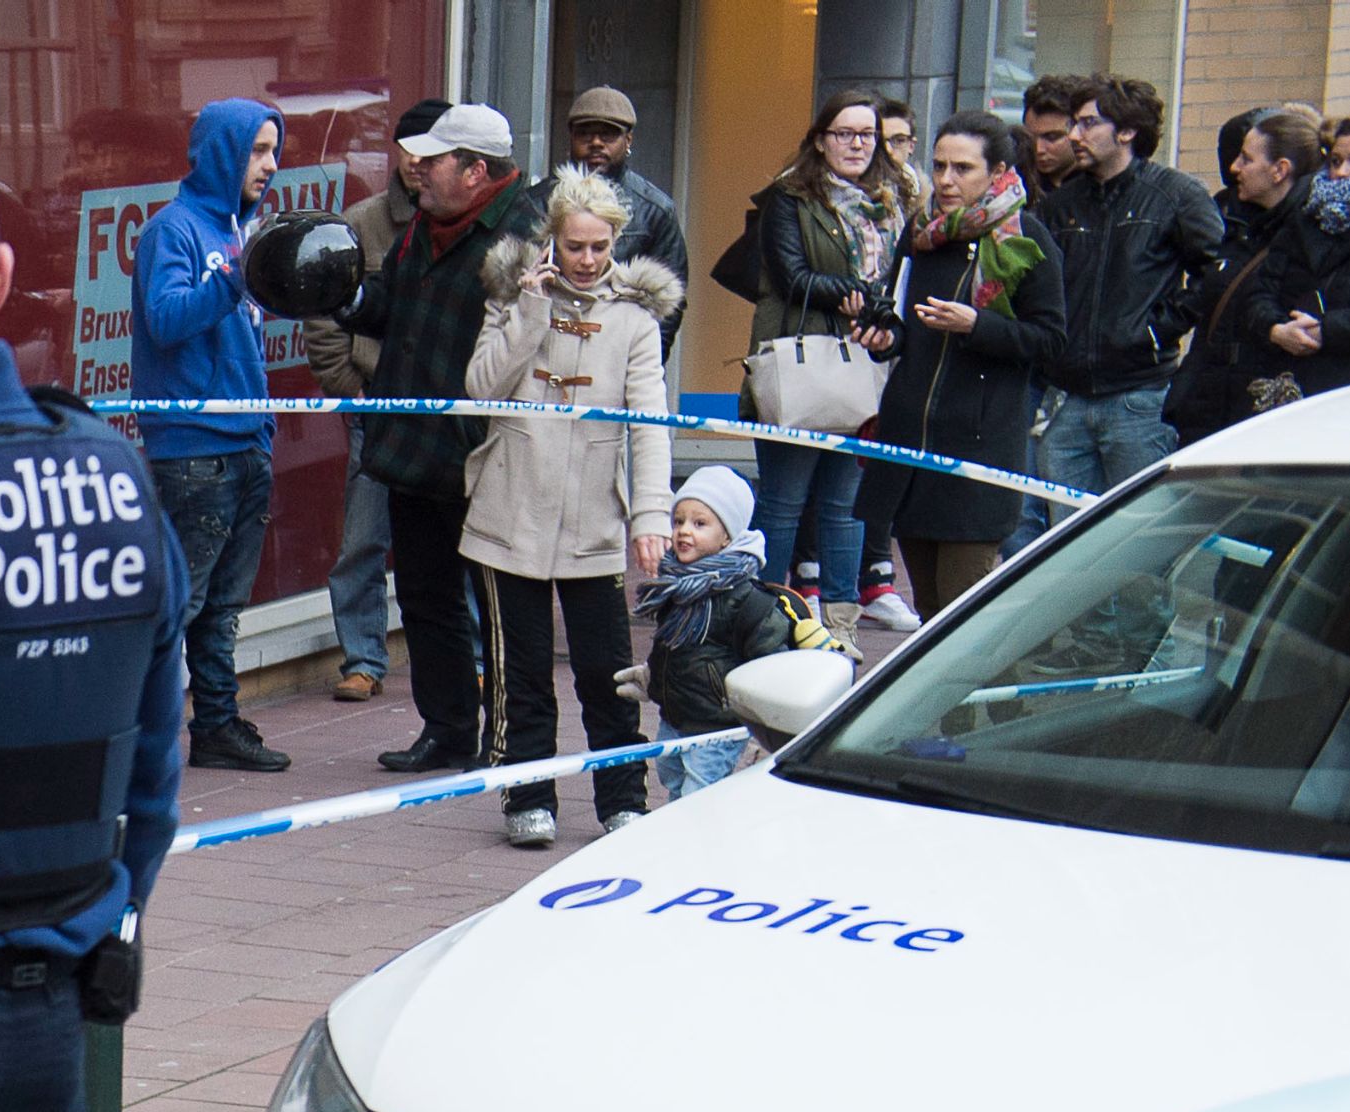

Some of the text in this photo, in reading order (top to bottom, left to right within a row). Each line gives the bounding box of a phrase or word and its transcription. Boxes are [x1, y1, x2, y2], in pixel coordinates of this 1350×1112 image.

[80, 306, 133, 344] Brux
[79, 358, 133, 399] Ense
[645, 887, 965, 953] Police
